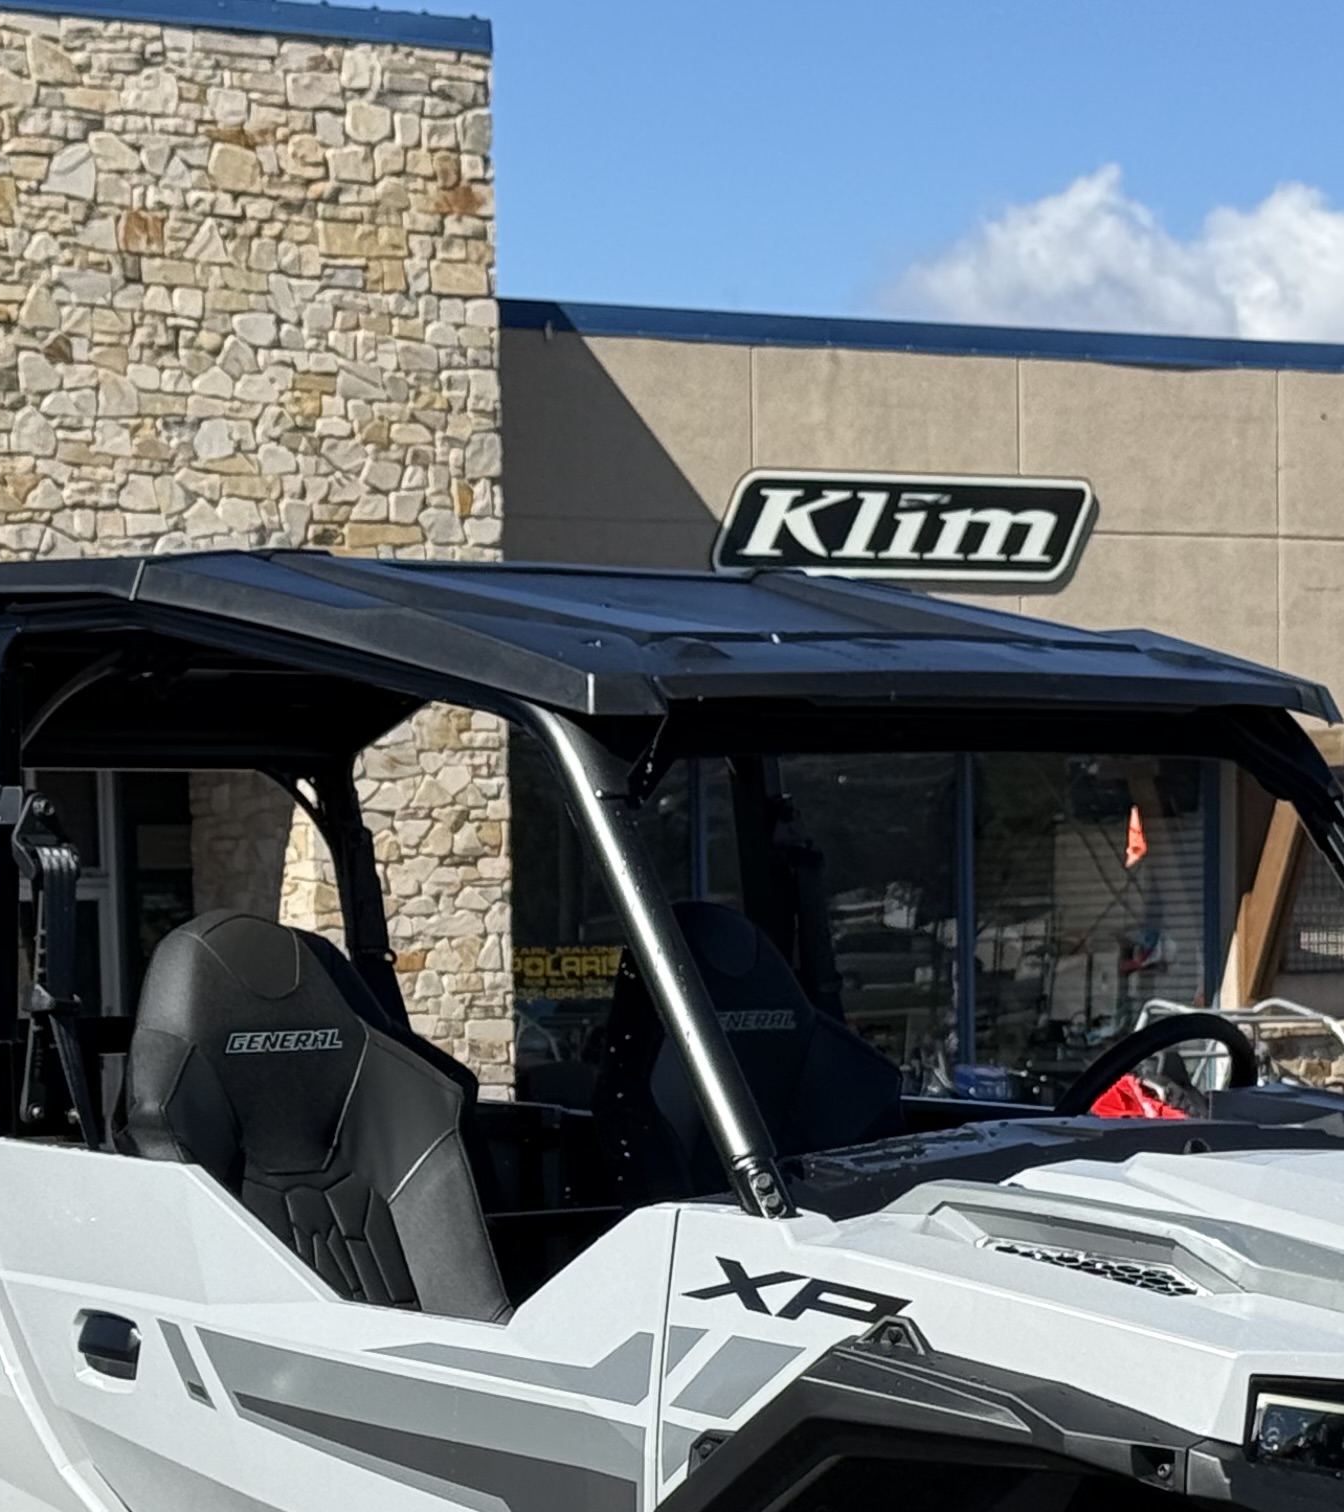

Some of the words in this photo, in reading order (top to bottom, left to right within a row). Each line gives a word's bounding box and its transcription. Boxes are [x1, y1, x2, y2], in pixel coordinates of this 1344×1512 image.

[737, 487, 1058, 562] Klim
[224, 1027, 343, 1055] GENERAL
[680, 1255, 913, 1323] XP
